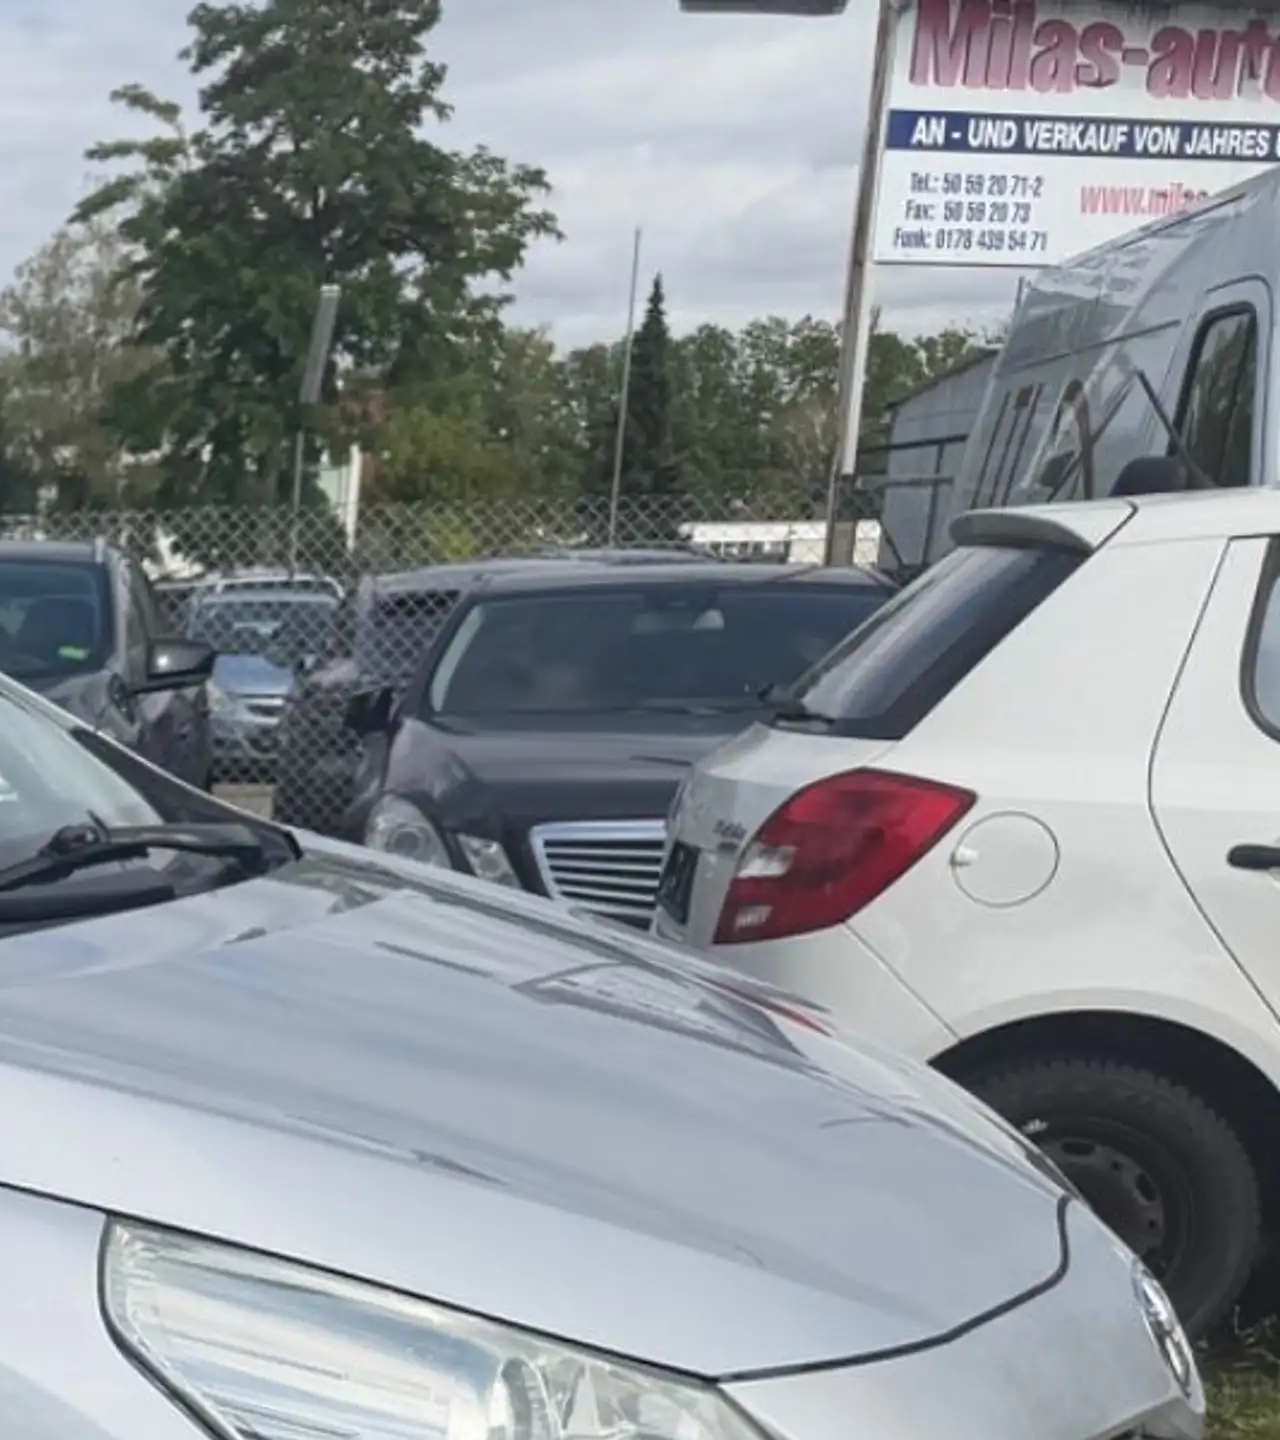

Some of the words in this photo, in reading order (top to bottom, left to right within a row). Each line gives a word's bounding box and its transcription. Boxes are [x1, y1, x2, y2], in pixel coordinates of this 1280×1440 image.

[910, 115, 946, 146] AN
[967, 118, 1017, 149] UND
[1024, 121, 1128, 152] VERKAUF
[1133, 125, 1180, 154] VON
[1184, 127, 1271, 157] JAHRES
[942, 172, 962, 194] 50
[988, 174, 1007, 195] 20
[905, 199, 936, 221] Fax:
[893, 226, 932, 249] Funk:
